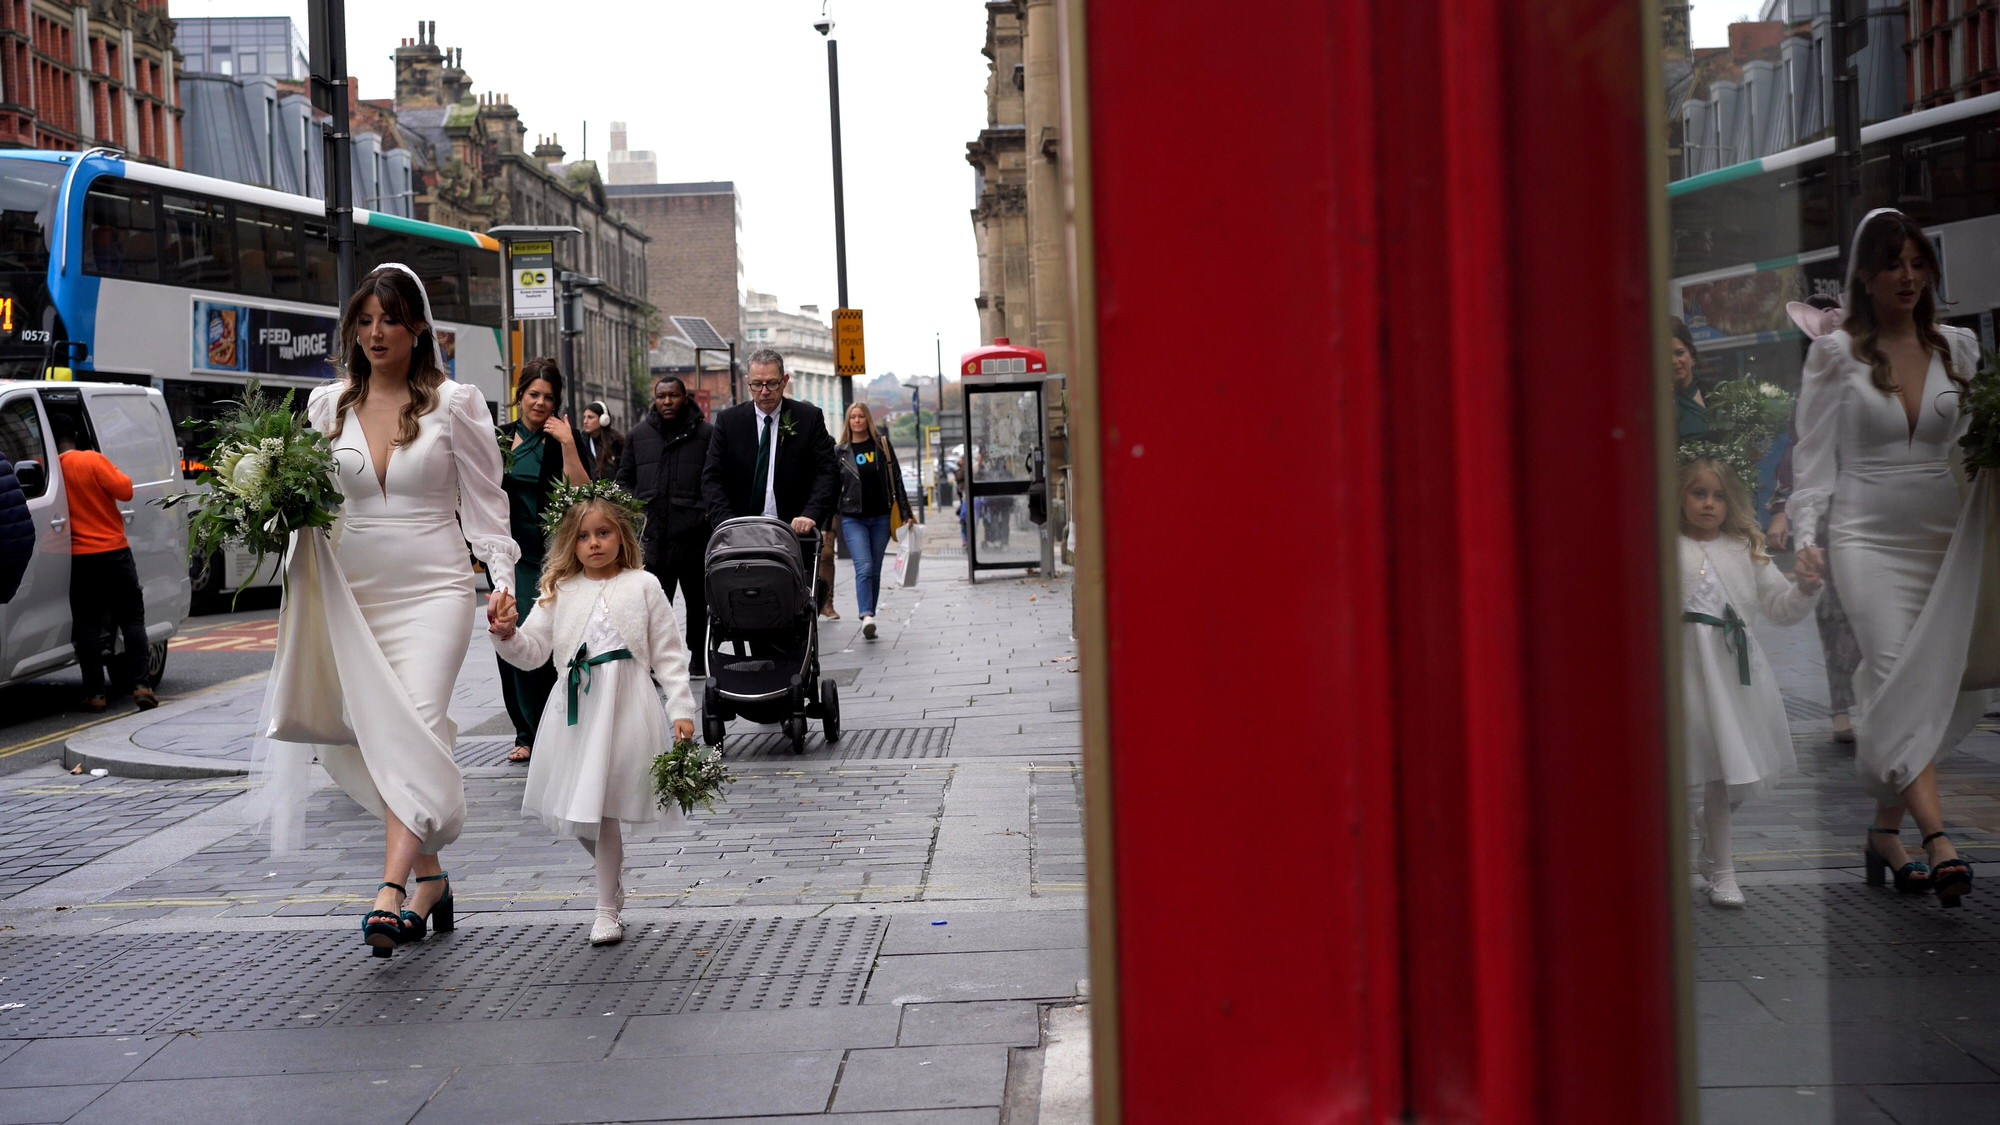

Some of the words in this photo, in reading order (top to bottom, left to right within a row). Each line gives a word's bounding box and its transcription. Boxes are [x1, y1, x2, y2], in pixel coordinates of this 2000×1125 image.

[842, 325, 860, 333] HELP
[22, 330, 50, 342] 10573
[259, 328, 291, 345] FEED
[840, 338, 863, 346] POINT
[293, 333, 327, 357] URGE
